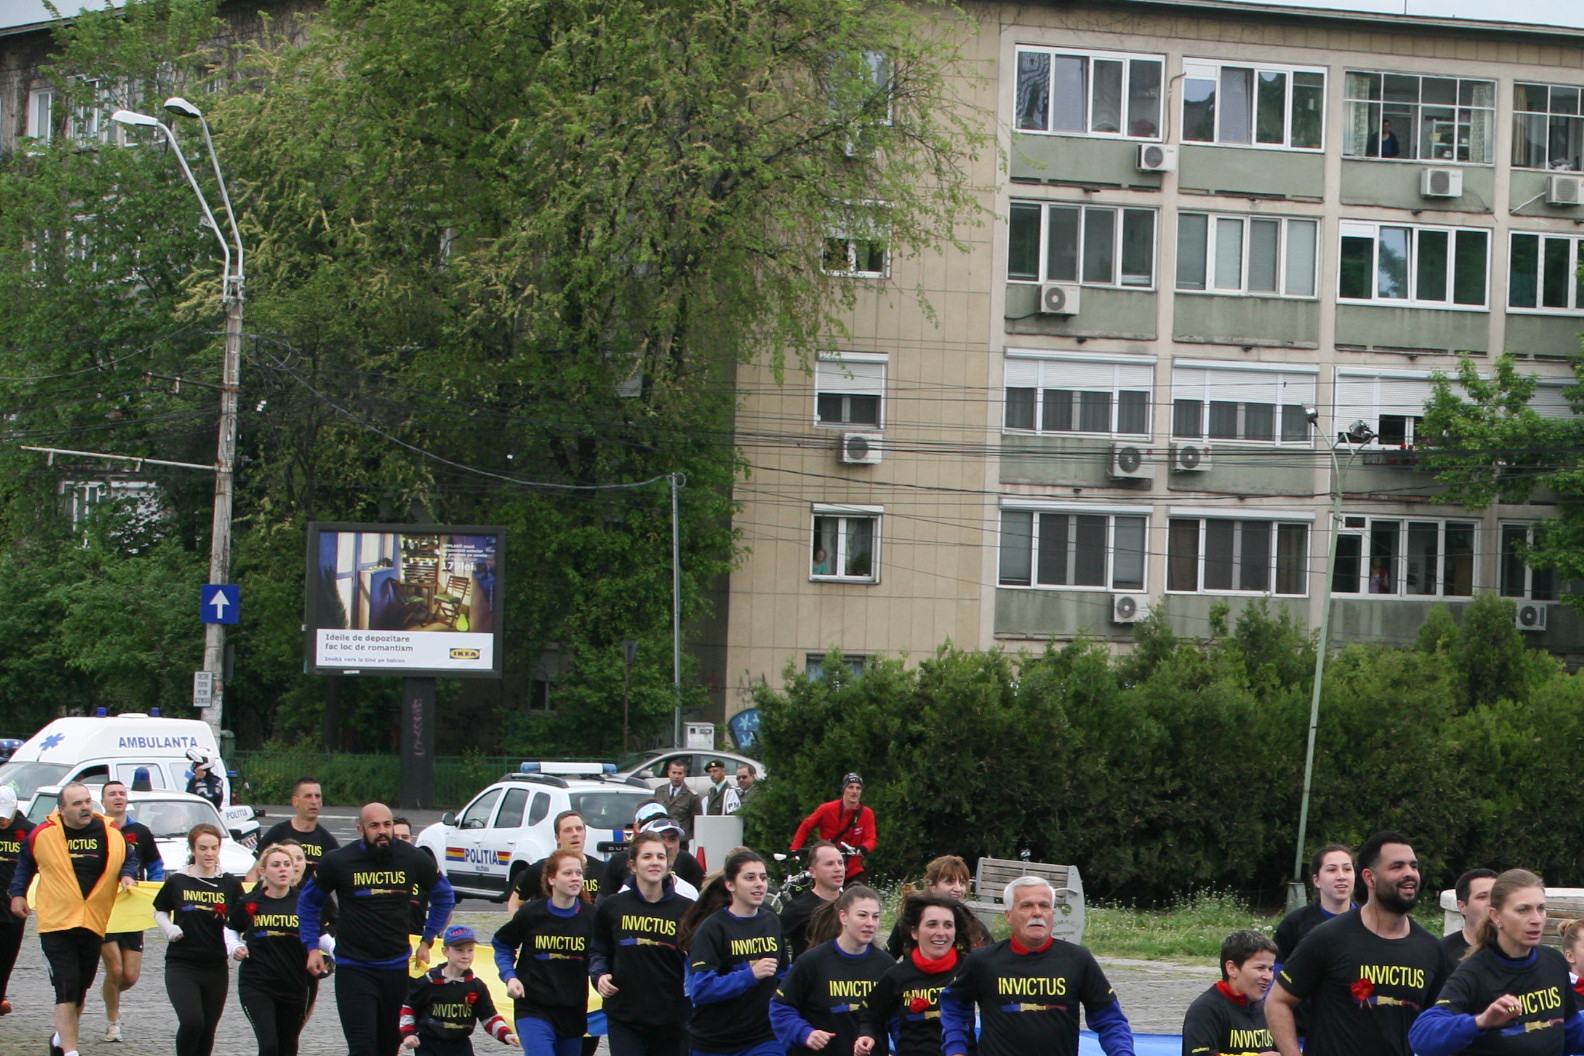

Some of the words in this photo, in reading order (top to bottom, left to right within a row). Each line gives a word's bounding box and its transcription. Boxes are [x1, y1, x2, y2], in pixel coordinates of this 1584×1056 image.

[325, 633, 350, 641] Ideile
[352, 634, 363, 642] de
[365, 635, 410, 643] depozitare
[465, 848, 500, 865] POLITIA
[353, 871, 406, 886] INVICTUS
[183, 889, 225, 904] INVICTUS
[621, 915, 677, 936] INVICTUS
[535, 935, 585, 952] INVICTUS
[731, 936, 778, 956] INVICTUS
[998, 977, 1066, 996] INVICTUS
[1230, 1029, 1274, 1049] INVICTUS
